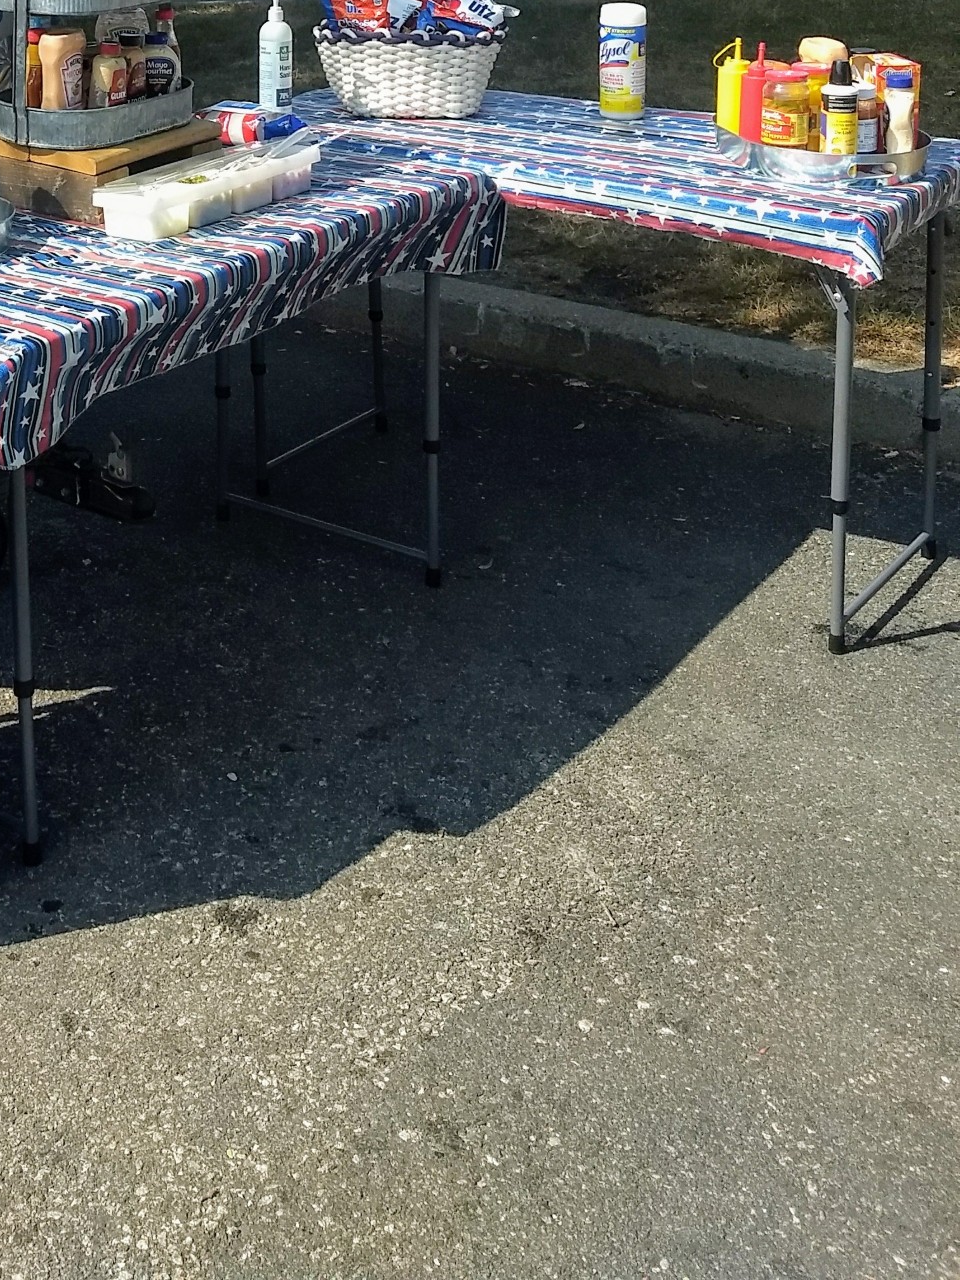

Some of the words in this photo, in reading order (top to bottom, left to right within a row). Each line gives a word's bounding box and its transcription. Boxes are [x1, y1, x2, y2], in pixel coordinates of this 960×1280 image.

[468, 0, 496, 22] utz
[601, 41, 630, 62] Lysol
[147, 61, 168, 70] Mayo
